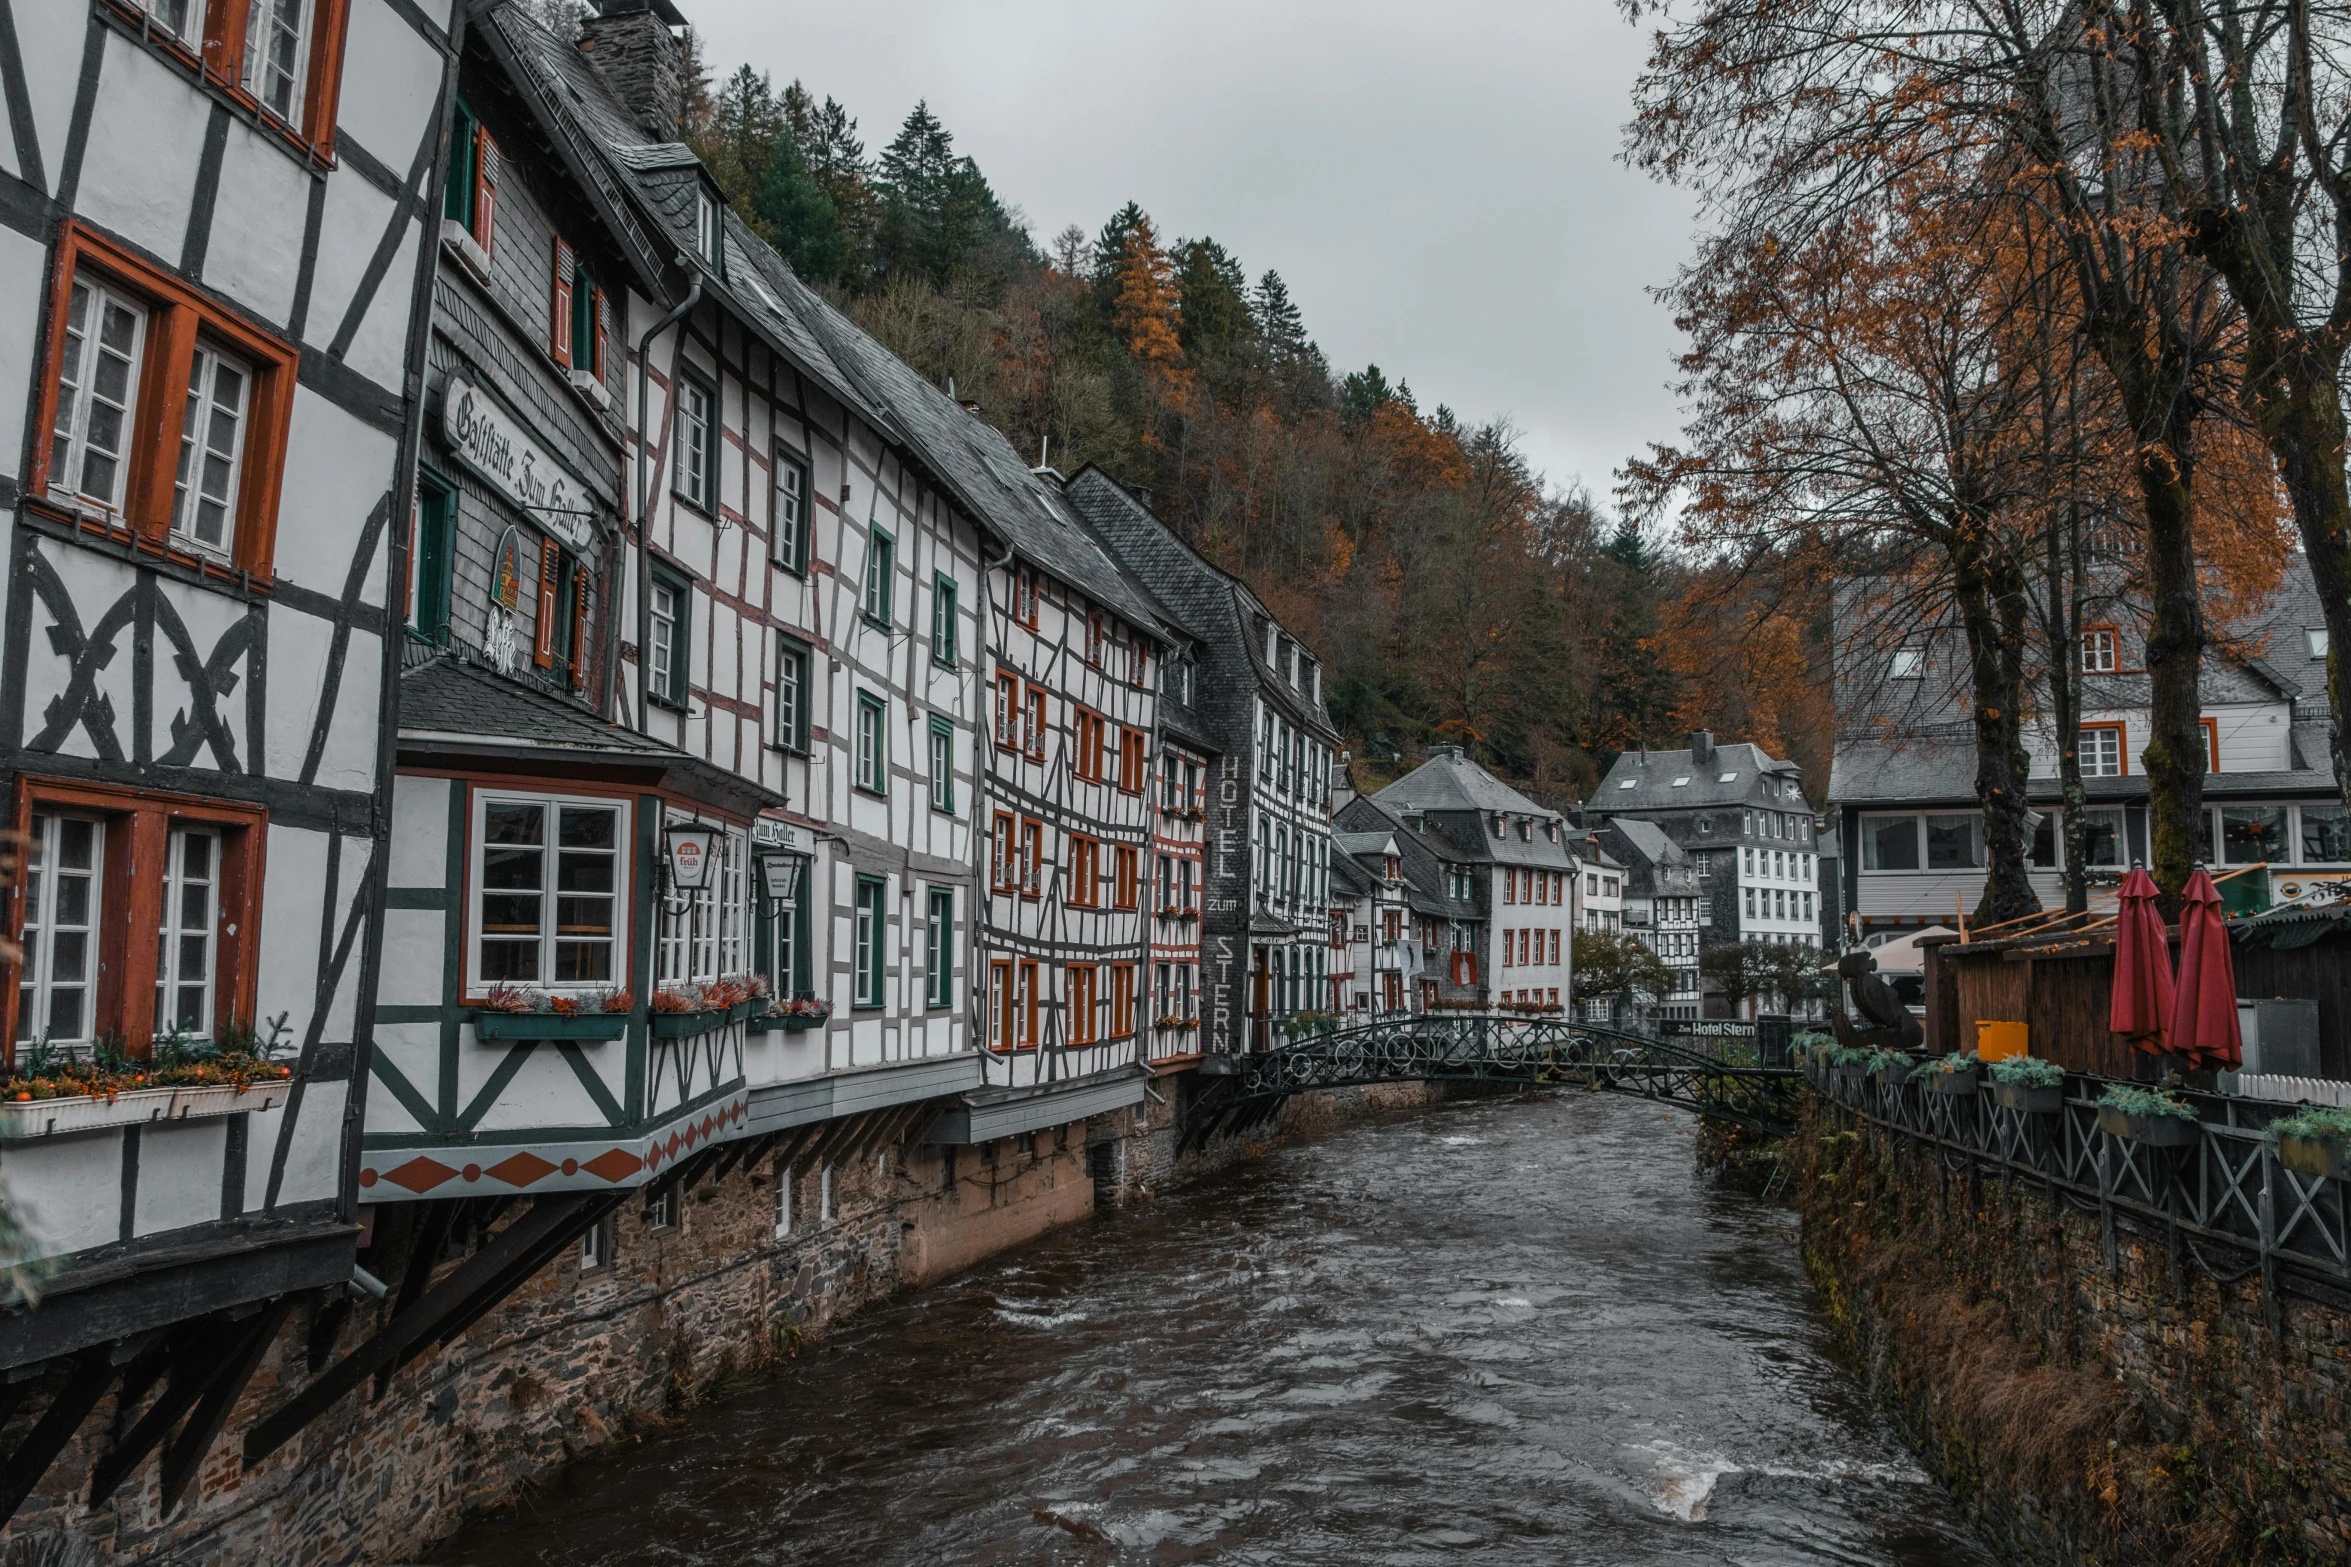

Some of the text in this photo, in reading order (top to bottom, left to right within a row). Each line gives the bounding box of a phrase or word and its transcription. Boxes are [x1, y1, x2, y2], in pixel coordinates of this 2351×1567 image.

[1218, 755, 1239, 879] HOTEL
[771, 821, 796, 844] Haller
[679, 856, 698, 867] früh
[1207, 898, 1238, 912] zum
[1211, 936, 1233, 1054] STERN
[1692, 1022, 1722, 1036] Hotel
[1723, 1022, 1755, 1037] Stern
